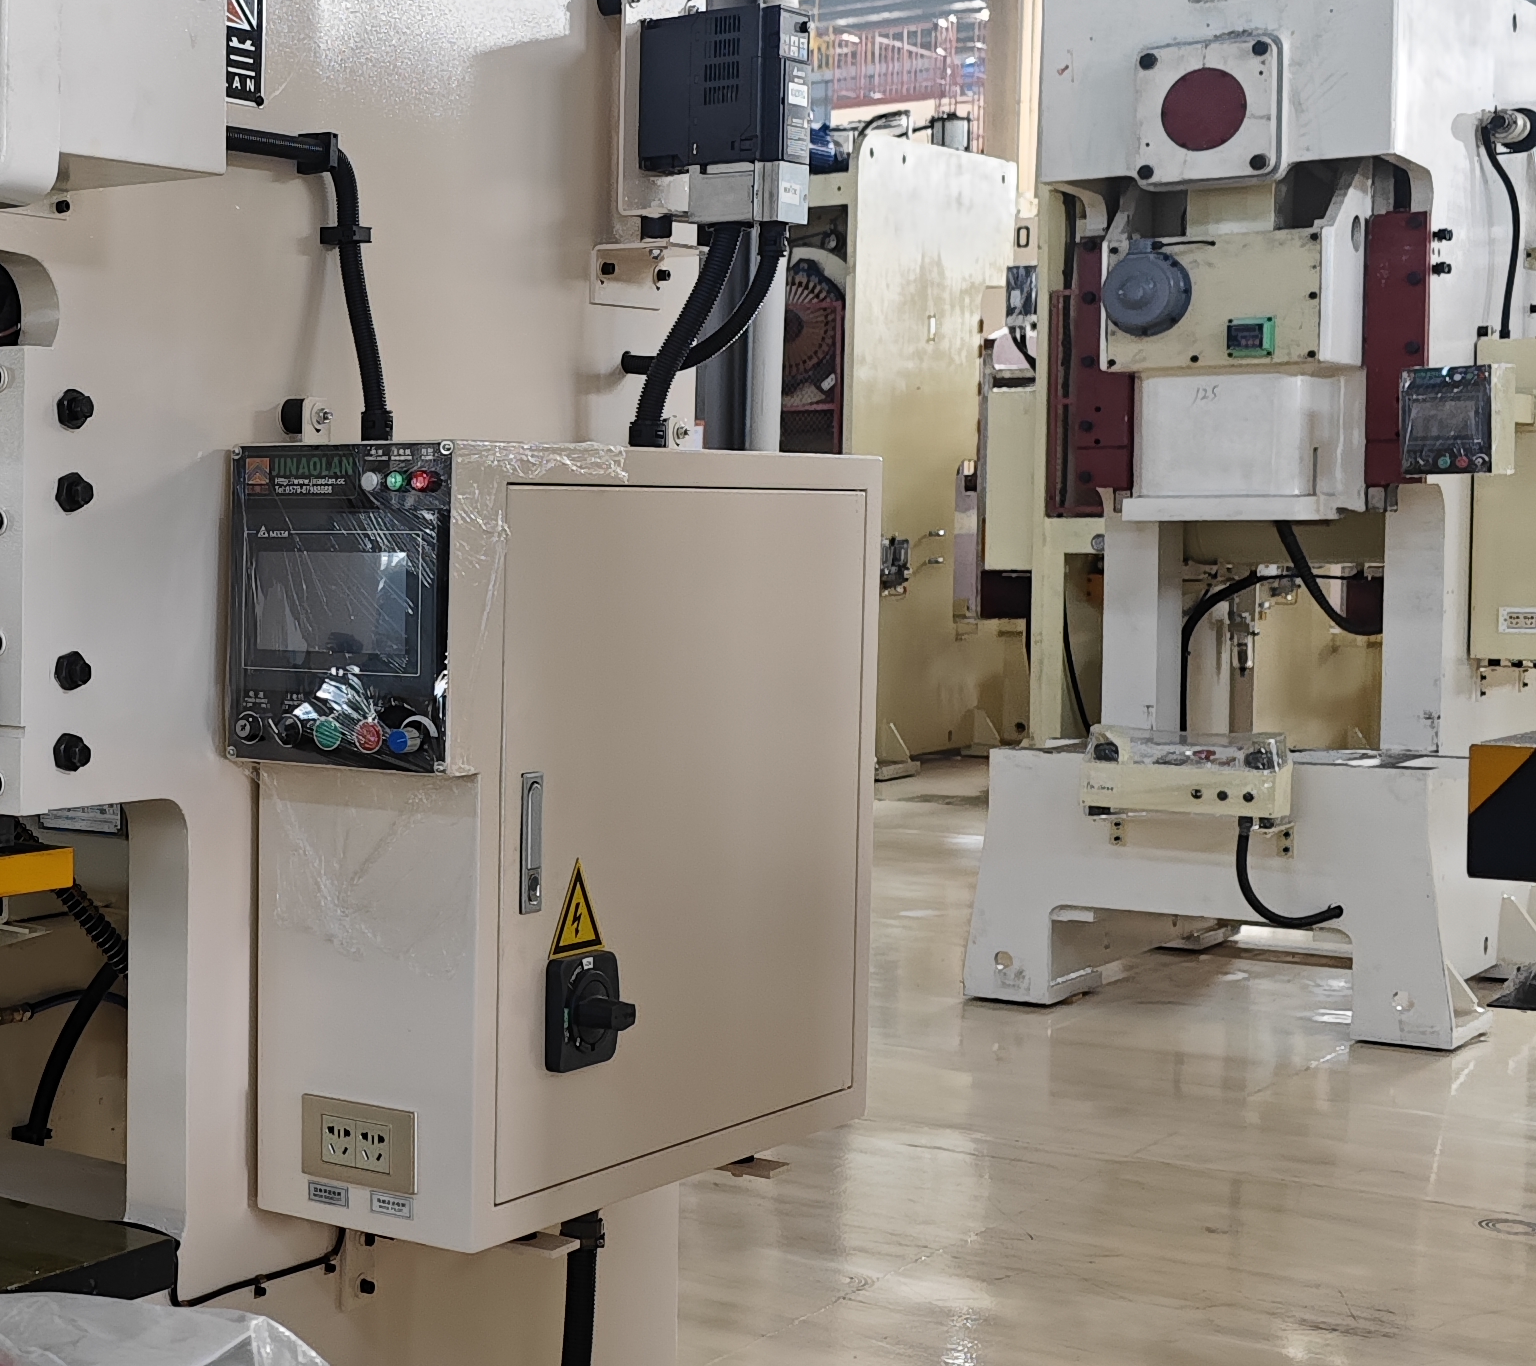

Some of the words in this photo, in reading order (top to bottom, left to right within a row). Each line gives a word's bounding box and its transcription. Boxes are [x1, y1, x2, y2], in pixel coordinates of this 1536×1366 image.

[226, 75, 255, 93] AN
[1191, 384, 1219, 407] 125
[272, 457, 354, 476] JINAOLAN
